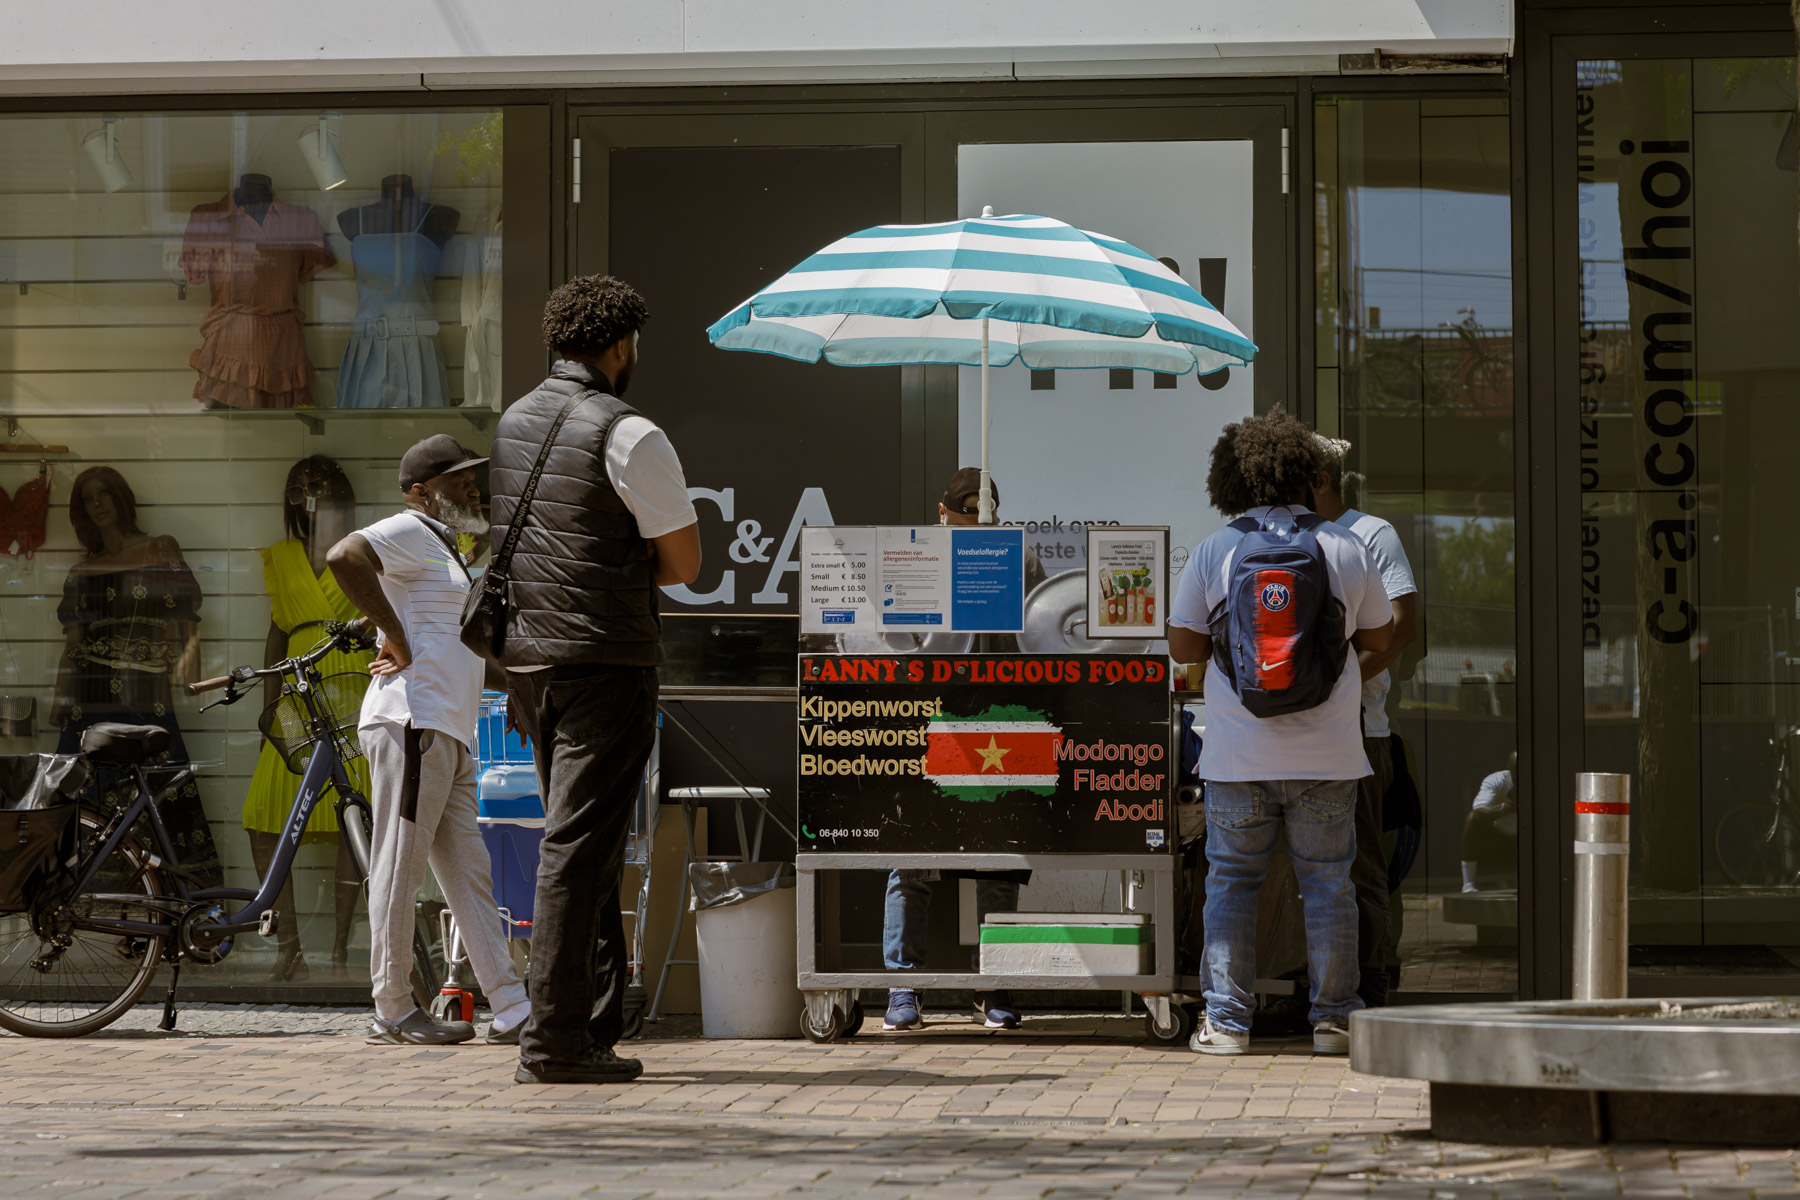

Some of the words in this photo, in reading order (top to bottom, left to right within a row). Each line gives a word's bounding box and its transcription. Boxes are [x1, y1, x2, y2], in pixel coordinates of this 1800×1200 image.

[1618, 140, 1698, 645] c-a.com/hoi
[539, 425, 561, 461] SERIES
[523, 466, 541, 502] CLOUD
[514, 502, 531, 528] NINE
[502, 528, 521, 559] DOTS
[659, 487, 835, 605] C&A
[957, 548, 1008, 557] Voedselallergie?
[803, 659, 925, 682] LANNYS
[1088, 660, 1165, 683] FOOD
[800, 696, 942, 721] Kippenworst
[800, 725, 927, 747] Vleesworst
[800, 754, 928, 775] Bloedworst
[1052, 739, 1164, 766] Modongo
[1074, 769, 1164, 791] Fladder
[290, 788, 314, 846] ALTEC
[1095, 799, 1164, 821] Abodi
[819, 828, 848, 837] 06-840
[851, 829, 861, 837] 10
[863, 829, 879, 837] 350
